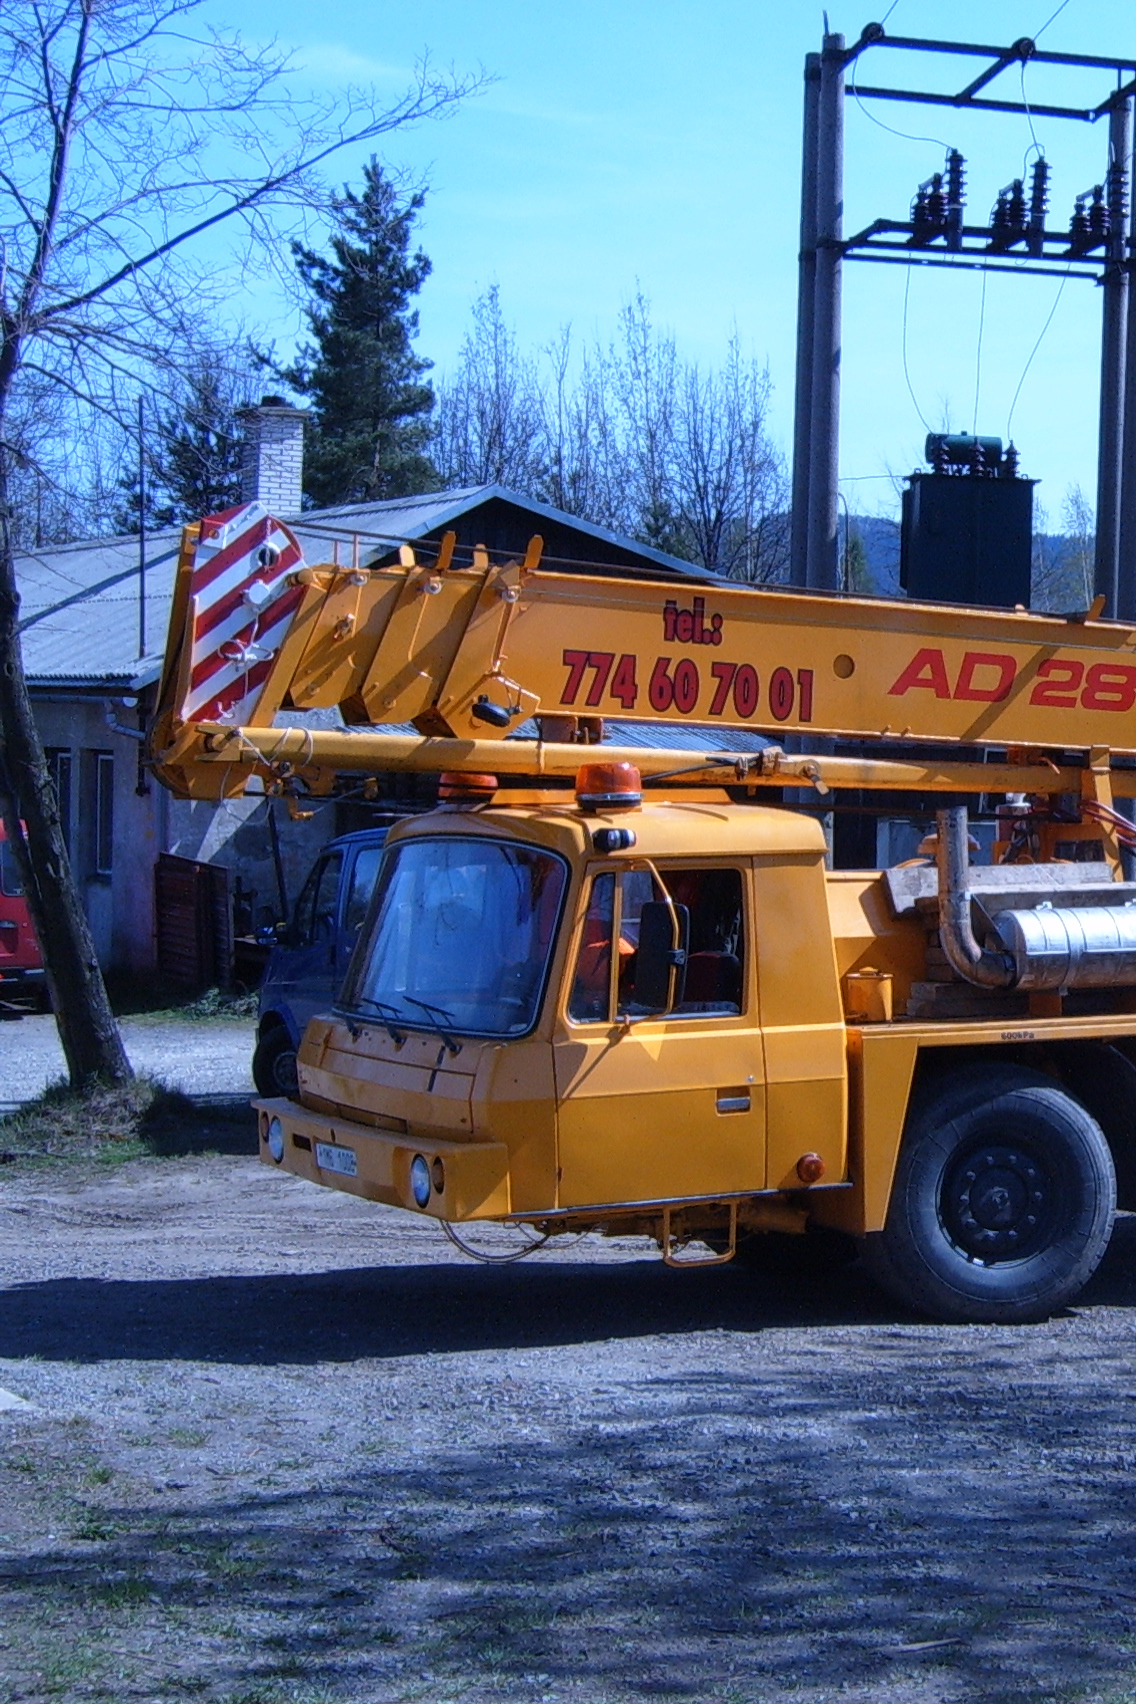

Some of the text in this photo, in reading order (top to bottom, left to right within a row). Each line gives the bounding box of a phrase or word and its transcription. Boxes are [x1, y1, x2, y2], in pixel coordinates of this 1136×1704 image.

[663, 596, 723, 646] tel.:
[559, 649, 813, 722] 774 60 70 01
[887, 648, 1017, 702] AD
